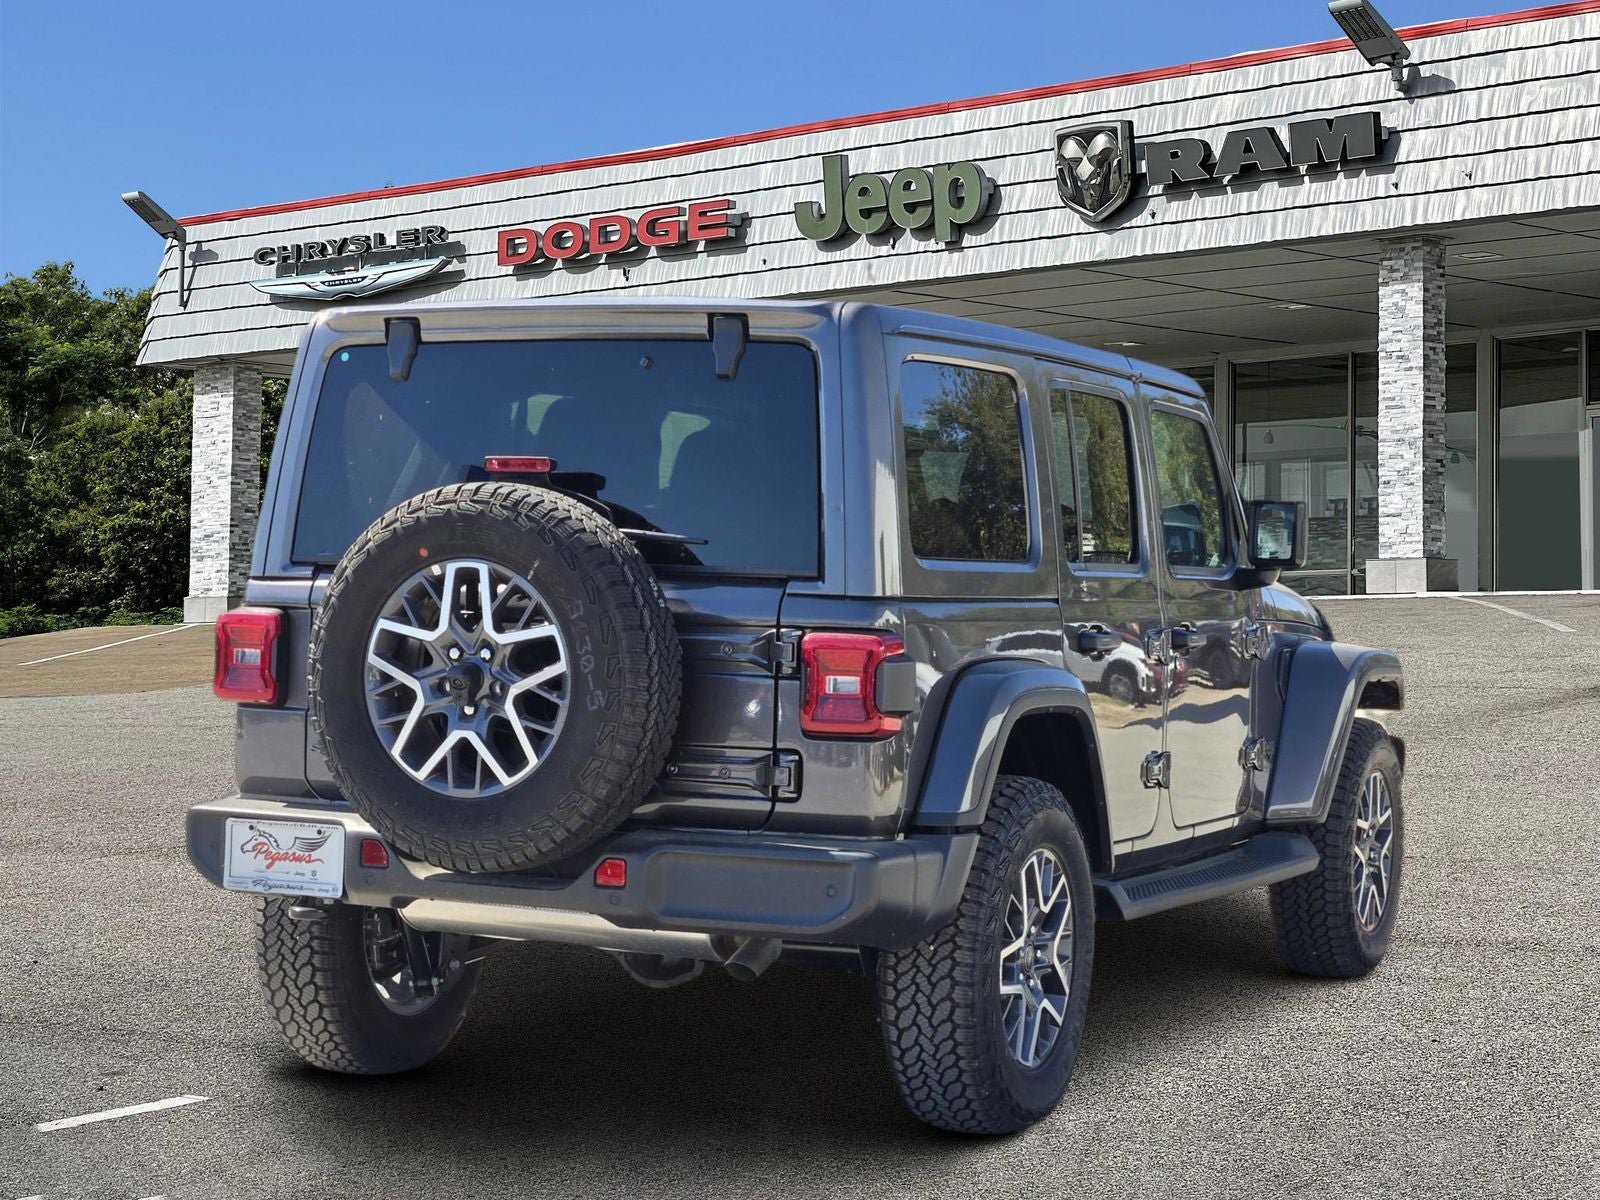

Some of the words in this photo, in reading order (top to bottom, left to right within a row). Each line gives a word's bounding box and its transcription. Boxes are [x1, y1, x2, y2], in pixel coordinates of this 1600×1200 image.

[1146, 112, 1380, 186] RAM
[794, 154, 986, 242] Jeep
[253, 225, 448, 266] CHRYSLER
[498, 200, 734, 266] DODGE
[324, 277, 363, 286] CHRYSLER
[251, 842, 325, 870] Pegasus
